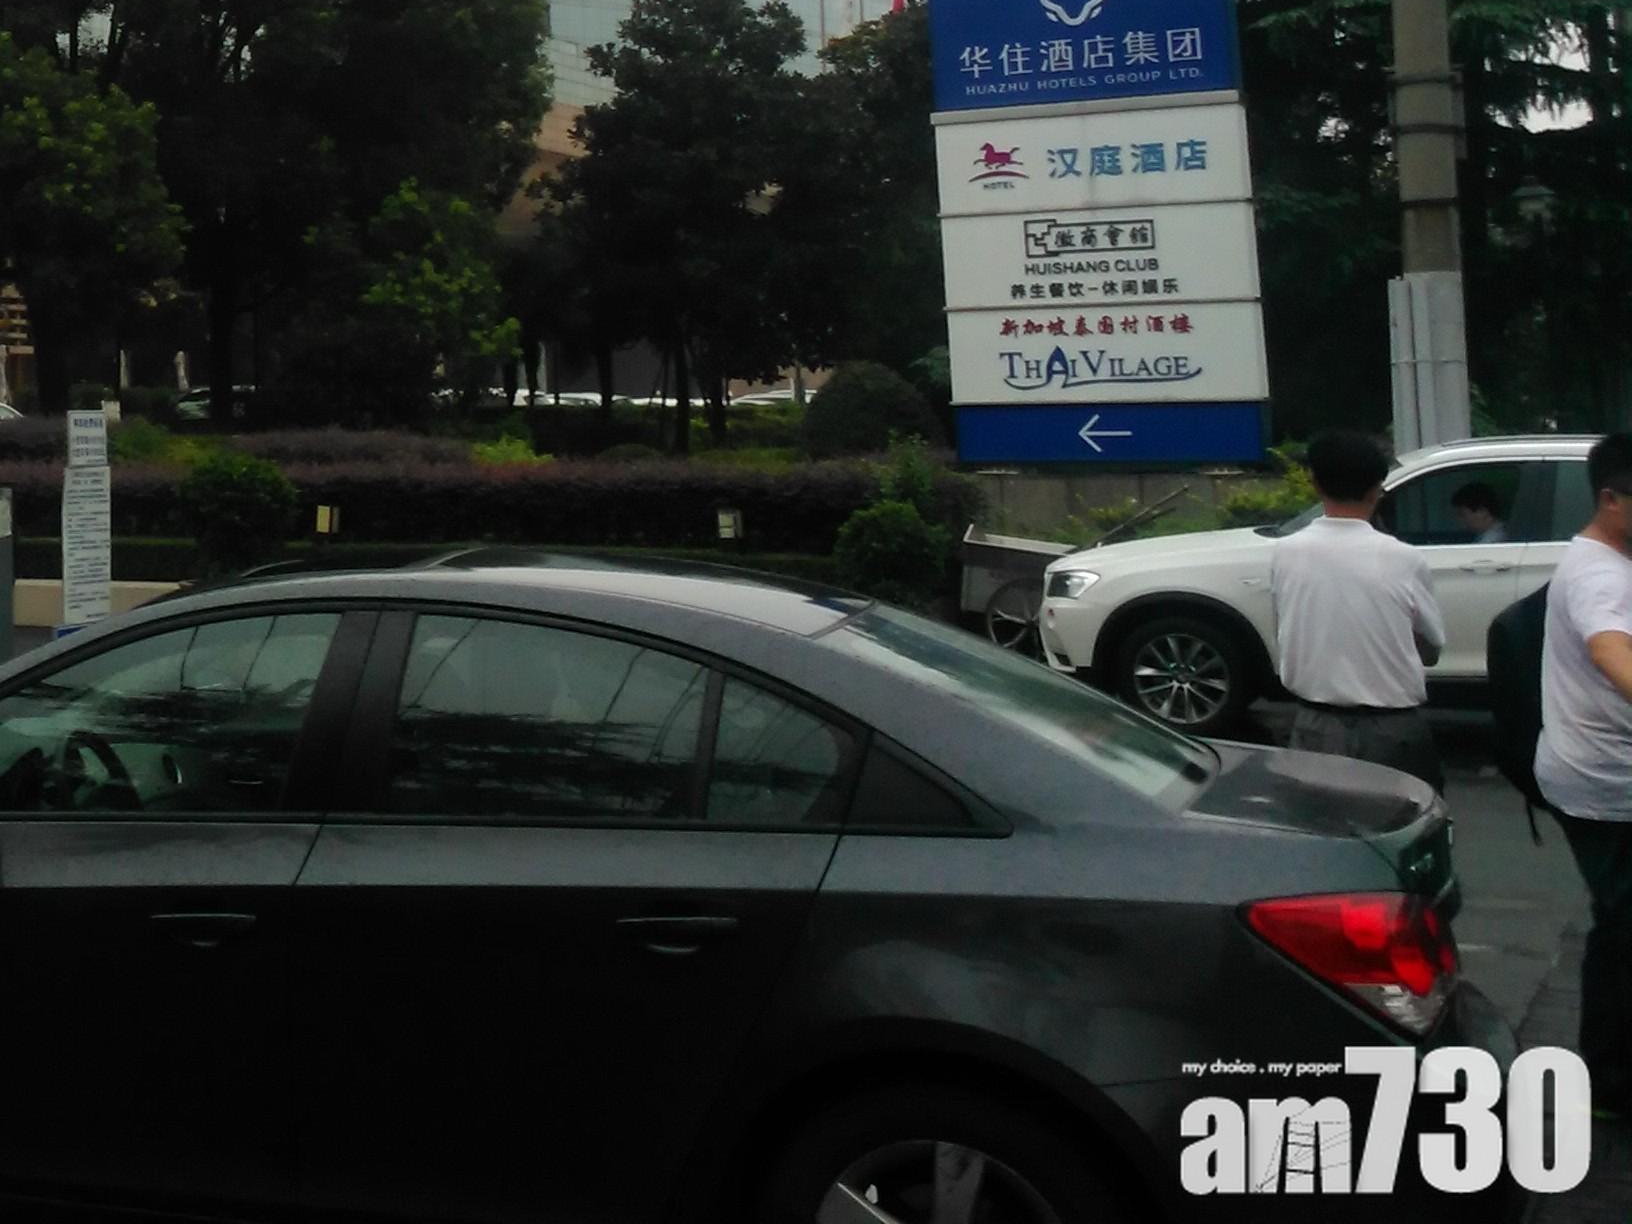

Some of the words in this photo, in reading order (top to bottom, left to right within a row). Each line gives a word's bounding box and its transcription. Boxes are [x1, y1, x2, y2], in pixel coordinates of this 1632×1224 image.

[959, 27, 1203, 79] 华住酒店集团
[965, 81, 1030, 96] HUAZHU
[1037, 74, 1097, 91] HOTELS
[1104, 70, 1161, 85] GROUP
[1047, 138, 1208, 179] 汉庭酒店
[982, 181, 1015, 191] HOTEL
[1024, 259, 1110, 276] HUISHANG
[1113, 257, 1160, 273] CLUB
